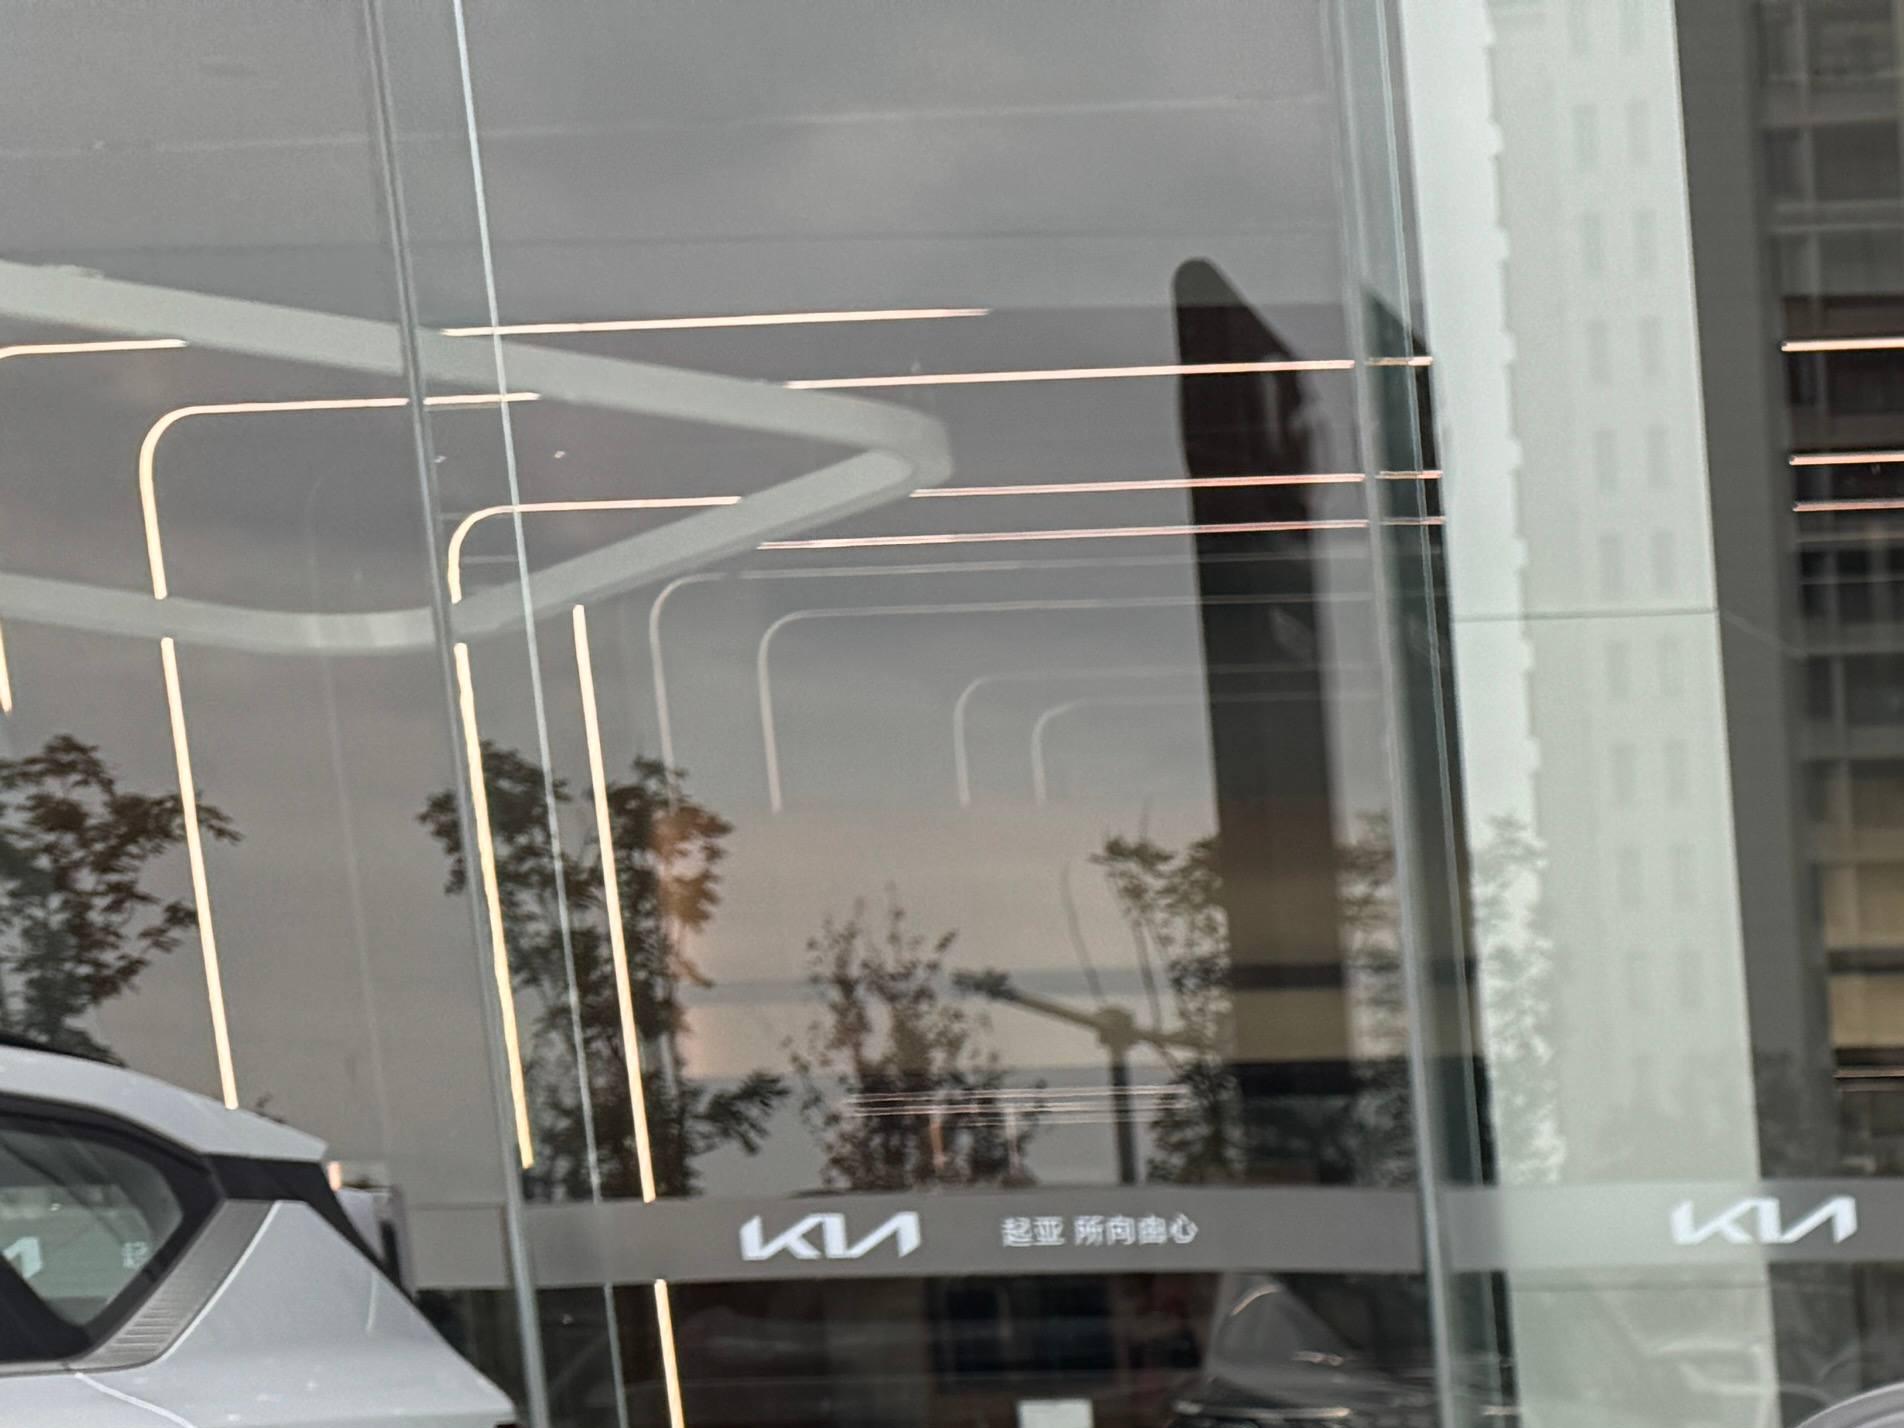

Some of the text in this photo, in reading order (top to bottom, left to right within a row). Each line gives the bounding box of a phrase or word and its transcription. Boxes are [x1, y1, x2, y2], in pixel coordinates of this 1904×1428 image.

[740, 1211, 921, 1261] KIA
[1001, 1215, 1065, 1247] 起亚
[1669, 1196, 1858, 1244] KIA
